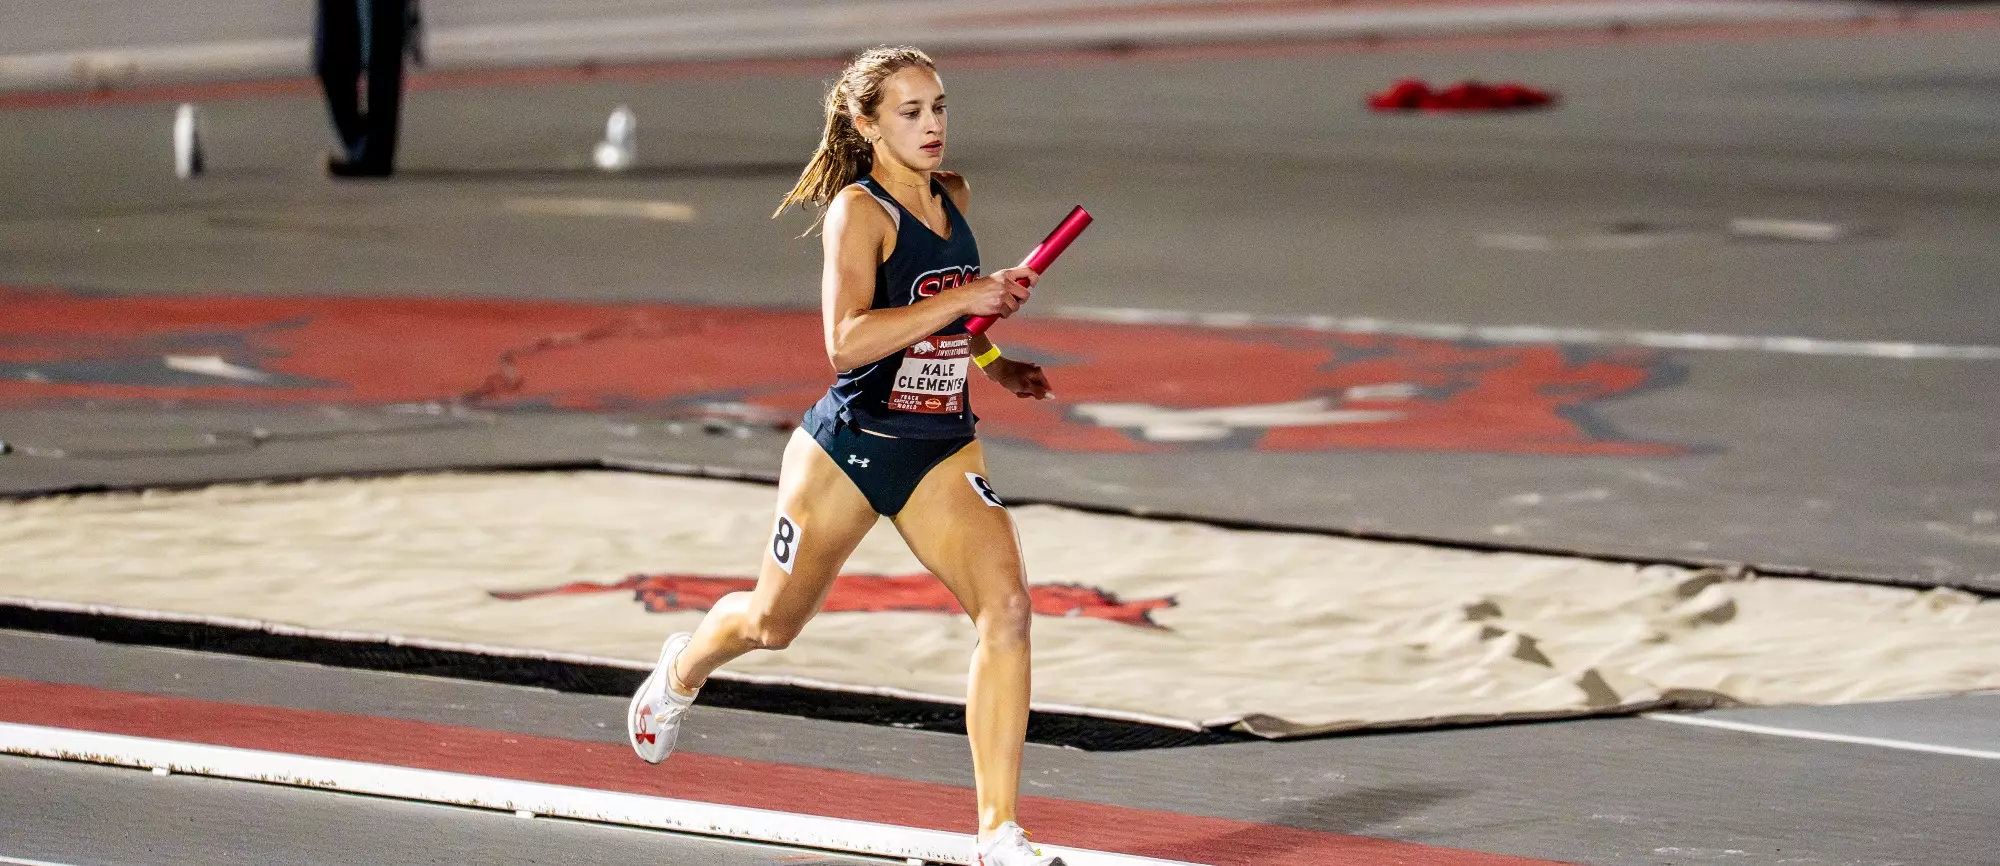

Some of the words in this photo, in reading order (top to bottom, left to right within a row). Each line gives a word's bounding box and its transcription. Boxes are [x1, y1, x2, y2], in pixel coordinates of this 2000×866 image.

[921, 363, 955, 376] KALE
[898, 376, 964, 392] CLEMENTS
[773, 516, 795, 564] 8
